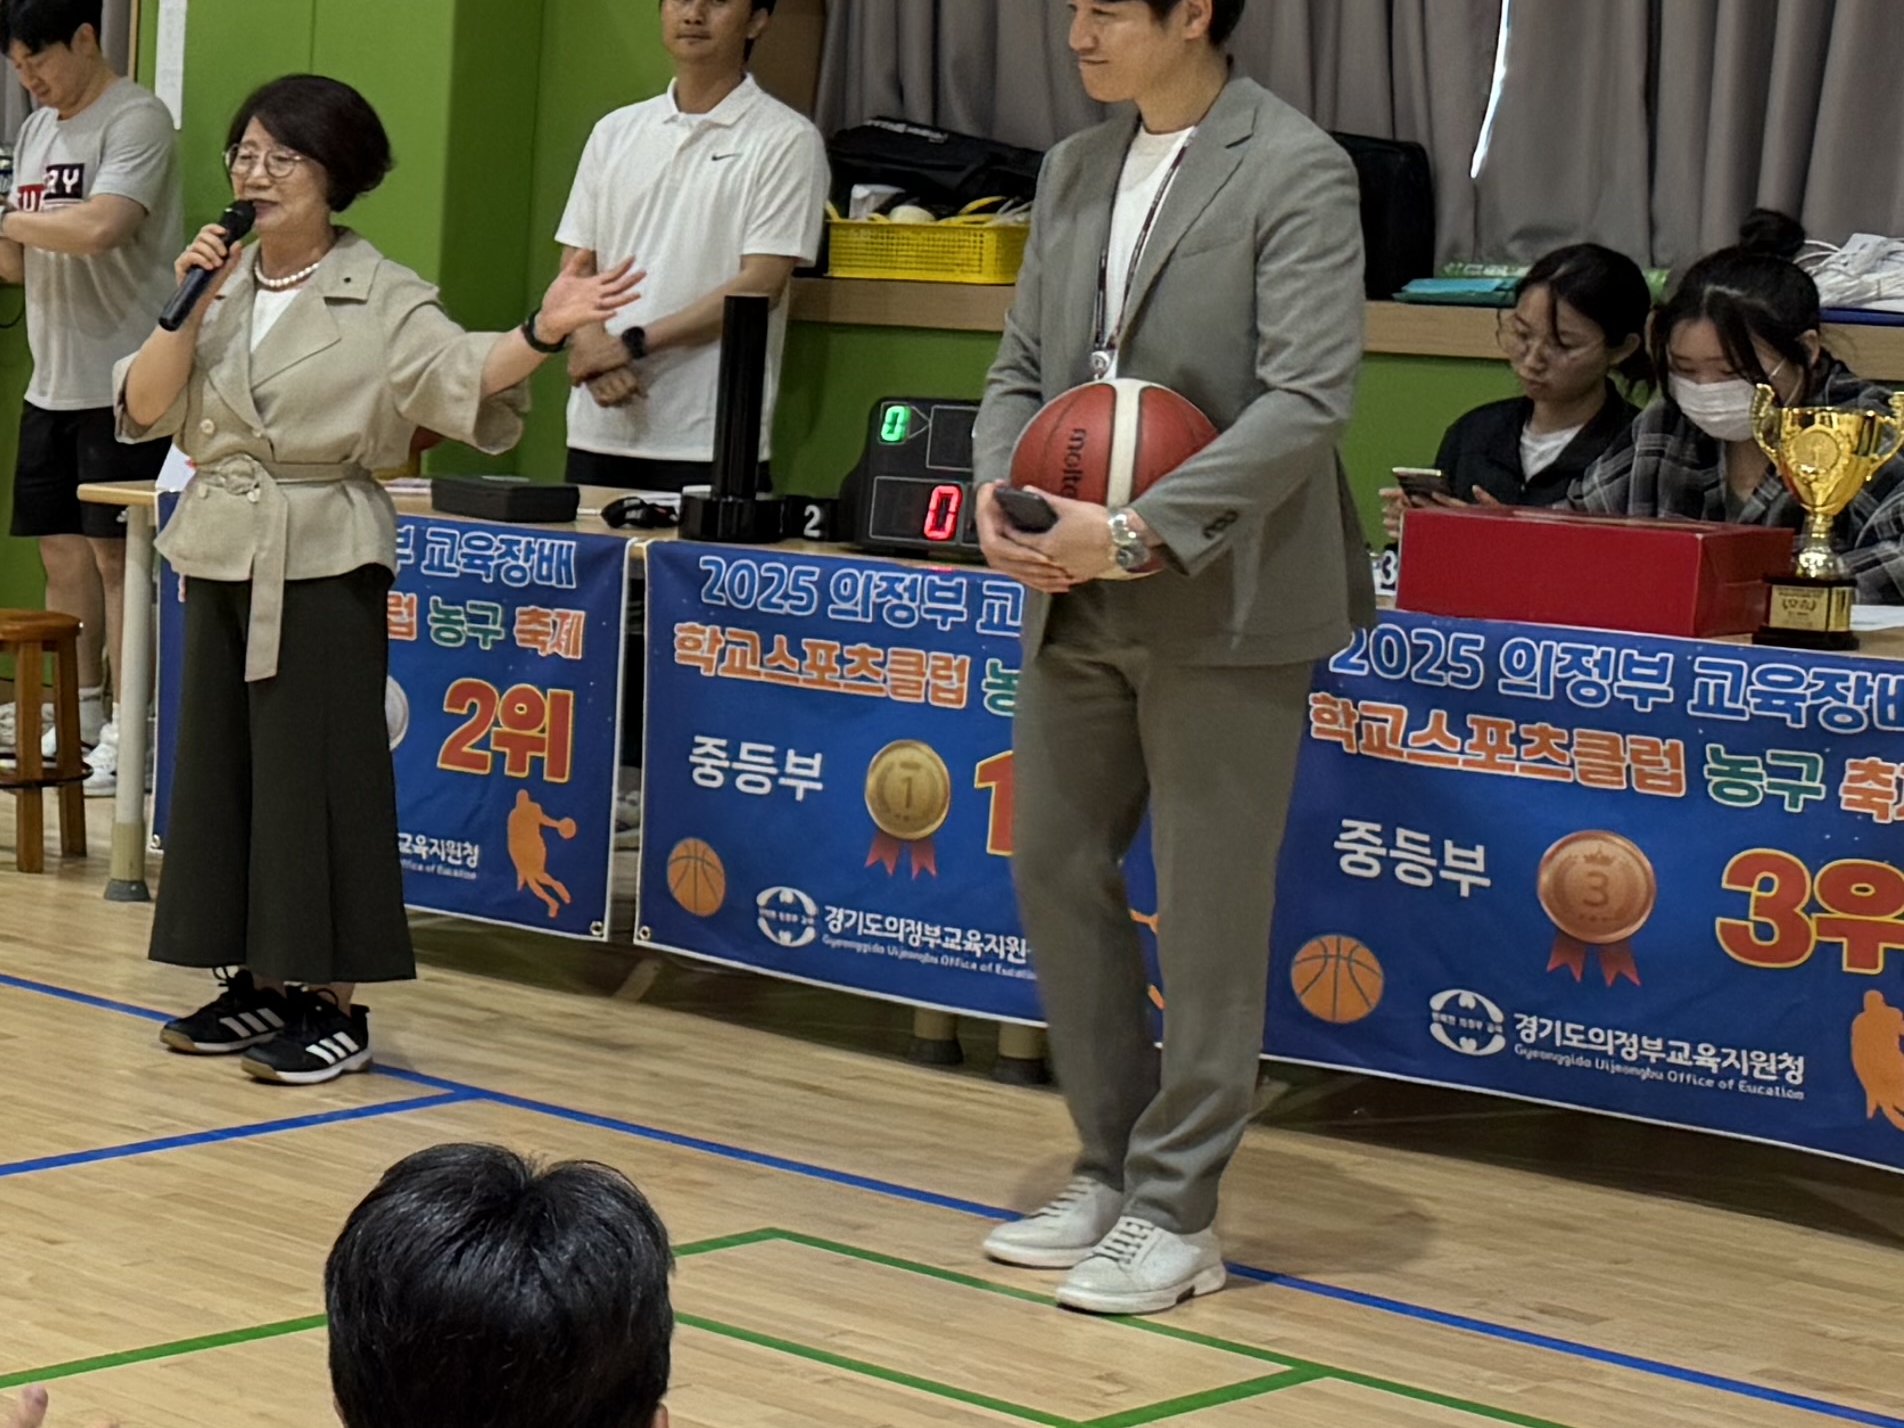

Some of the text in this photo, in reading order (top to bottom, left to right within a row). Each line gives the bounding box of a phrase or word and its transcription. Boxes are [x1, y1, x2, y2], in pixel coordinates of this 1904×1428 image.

[1060, 428, 1088, 499] molte
[803, 504, 823, 539] 2
[922, 483, 963, 542] 0
[421, 526, 578, 590] 교육장배
[426, 595, 506, 651] 농구
[513, 605, 586, 661] 축제
[699, 555, 1026, 638] 2025 의정부 교
[673, 621, 971, 711] 학교스포츠클럽
[1328, 623, 1486, 691] 2025
[1498, 636, 1675, 713] 의정부
[436, 677, 575, 784] 2위
[1308, 691, 1904, 824] 학교스포츠클럽 농구 축
[688, 734, 824, 802] 중등부
[973, 749, 1015, 857] 1
[397, 831, 480, 869] 교육지원청
[1333, 818, 1492, 899] 중등부
[823, 904, 1031, 965] 경기도의정부교육지원
[1513, 1012, 1805, 1086] 경기도의정부교육지원청
[1667, 1070, 1716, 1089] Office
[1718, 1078, 1735, 1090] of
